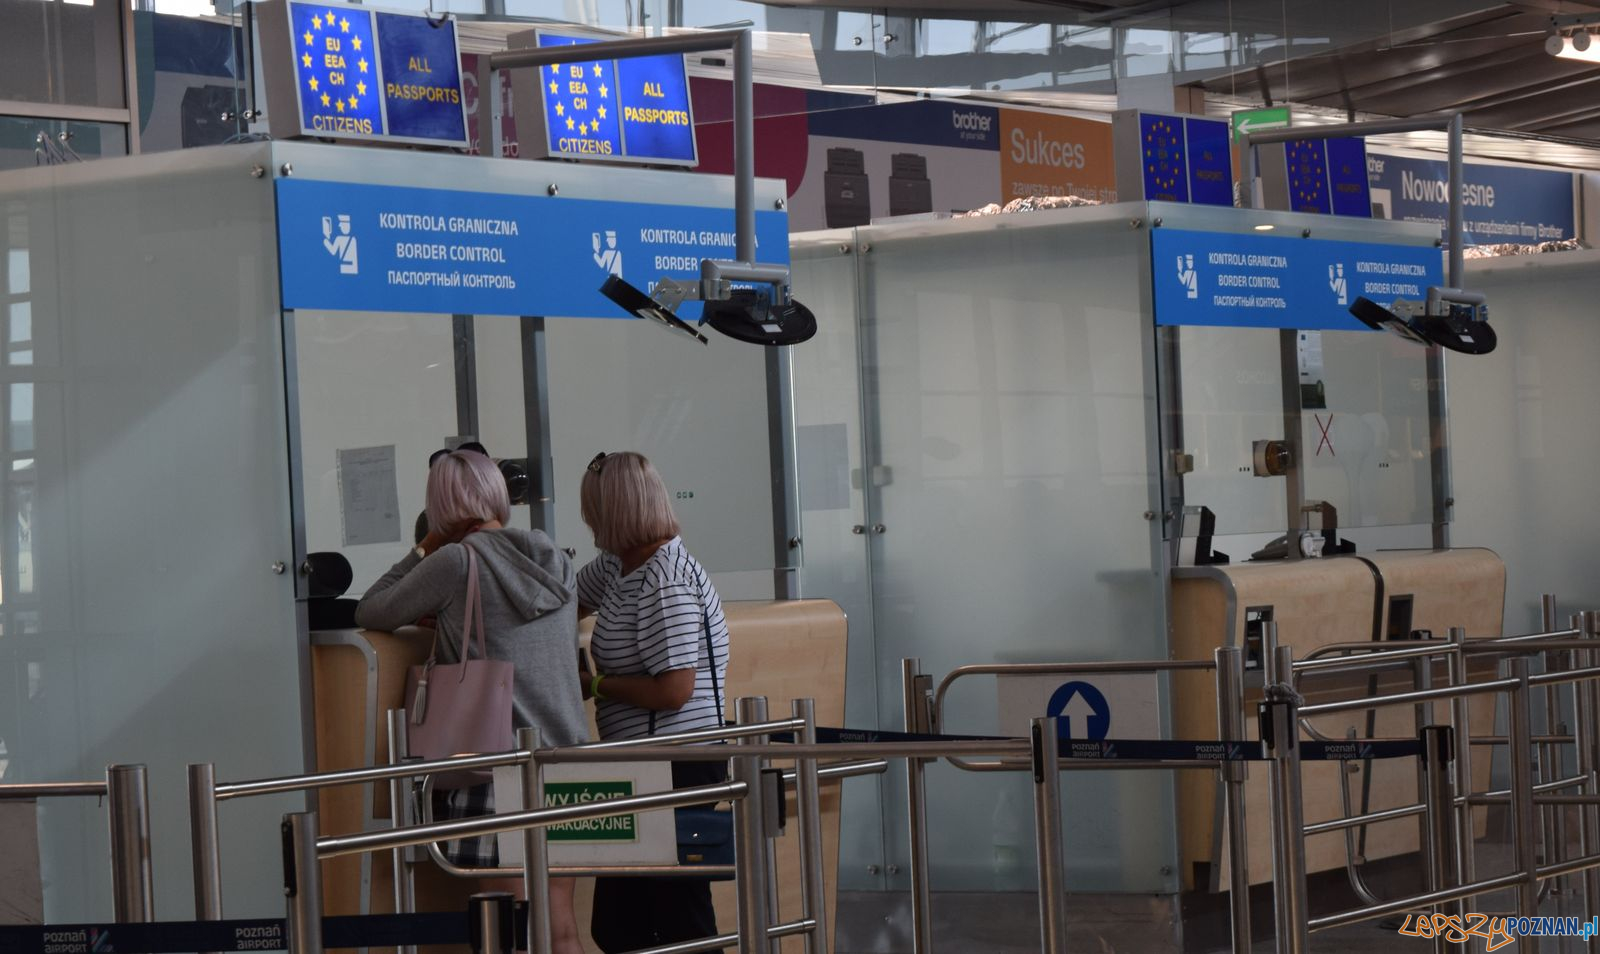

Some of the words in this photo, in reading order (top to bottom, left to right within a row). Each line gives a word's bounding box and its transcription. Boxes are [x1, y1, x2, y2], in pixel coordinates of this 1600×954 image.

[326, 37, 341, 52] EU
[324, 54, 347, 69] EEA
[409, 56, 433, 73] ALL
[329, 71, 345, 86] CH
[570, 65, 584, 78] EU
[387, 83, 460, 104] PASSPORTS
[569, 81, 588, 94] EEA
[643, 82, 665, 98] ALL
[573, 97, 587, 110] CH
[624, 106, 689, 126] PASSPORTS
[953, 110, 991, 131] brother
[312, 114, 373, 135] CITIZENS
[559, 137, 612, 155] CITIZENS
[1011, 127, 1085, 169] Sukces
[380, 213, 446, 231] KONTROLA
[449, 216, 519, 235] GRANICZNA
[1538, 223, 1563, 239] Brother
[640, 228, 696, 245] KONTROLA
[396, 242, 447, 260] BORDER
[450, 245, 506, 263] CONTROL
[1209, 252, 1246, 267] KONTROLA
[1247, 254, 1287, 269] GRANICZNA
[655, 255, 698, 271] BORDER
[1356, 261, 1389, 275] KONTROLA
[1390, 263, 1426, 277] GRANICZNA
[388, 270, 460, 287] ПАСПОРТНЫЙ
[463, 273, 516, 289] КОНТРОЛЬ
[1218, 274, 1247, 288] BORDER
[1248, 276, 1280, 289] CONTROL
[1365, 282, 1390, 294] BORDER
[1391, 283, 1420, 296] CONTROL
[1214, 295, 1254, 308] ПАСПОРТНЫЙ
[1255, 297, 1286, 309] КОНТРОЛЬ
